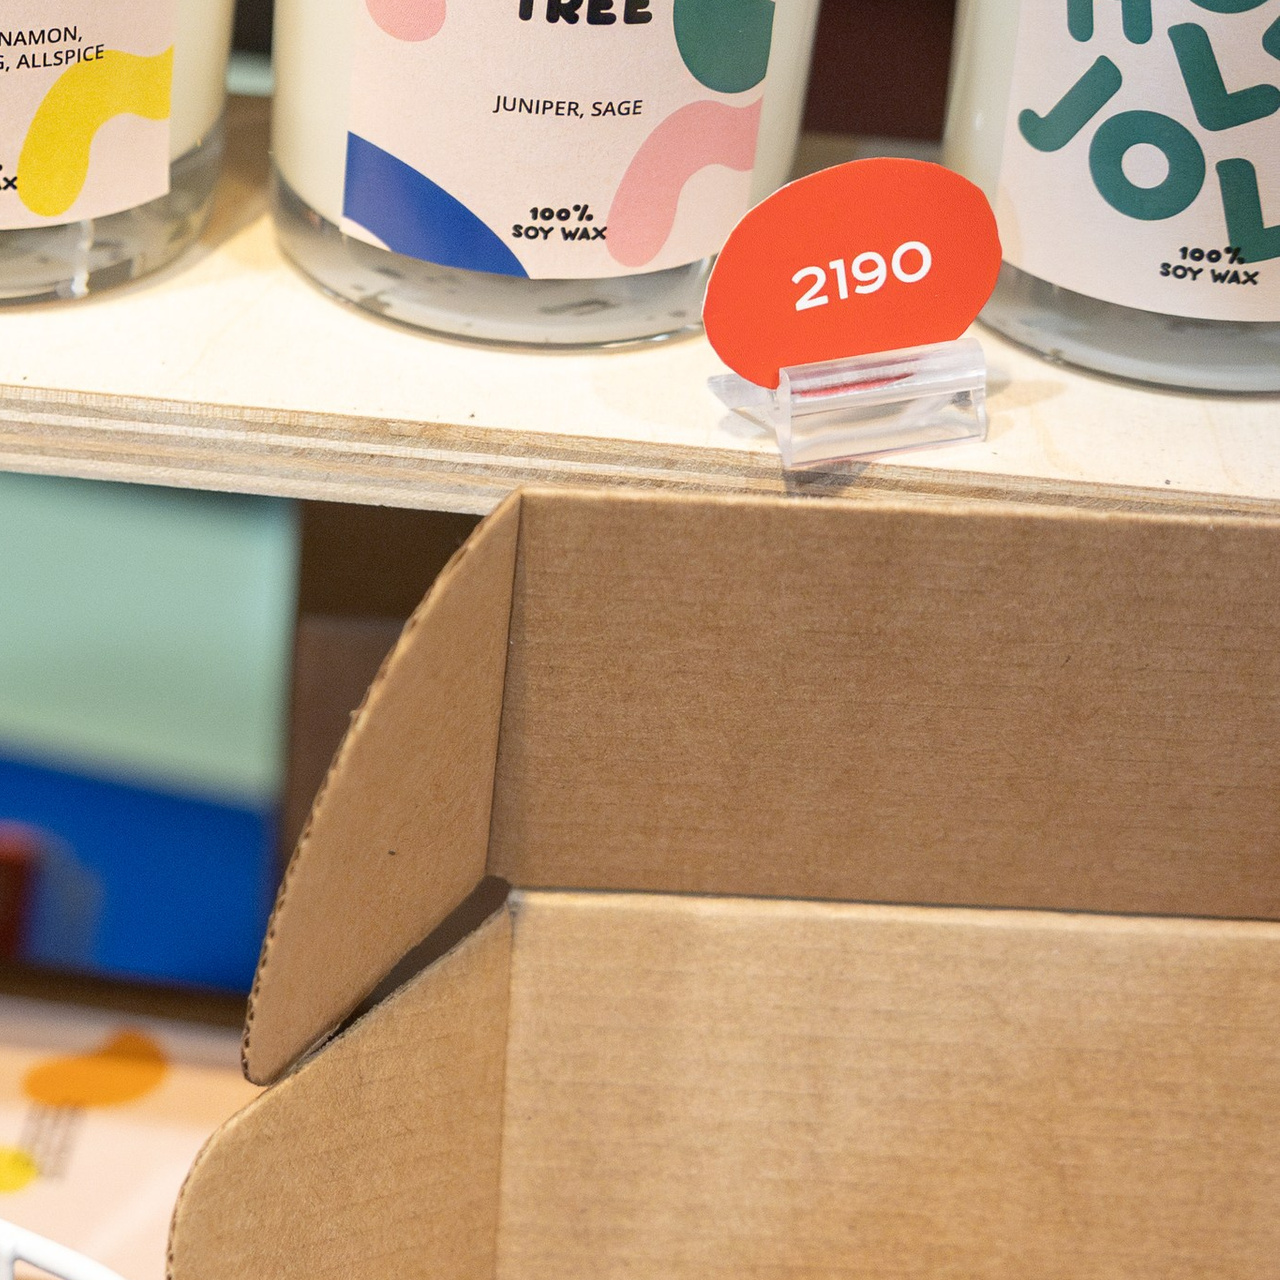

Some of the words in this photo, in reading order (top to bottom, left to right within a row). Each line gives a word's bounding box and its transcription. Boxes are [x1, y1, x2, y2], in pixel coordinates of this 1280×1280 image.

[14, 44, 106, 71] ALLSPICE
[492, 94, 585, 122] JUNIPER,
[589, 97, 644, 118] SAGE
[529, 204, 594, 222] 100%
[511, 224, 554, 240] SOY
[560, 224, 608, 241] WAX
[1179, 246, 1247, 265] 100%
[790, 239, 933, 312] 2190
[1160, 262, 1204, 281] SOY
[1210, 267, 1259, 286] WAX
